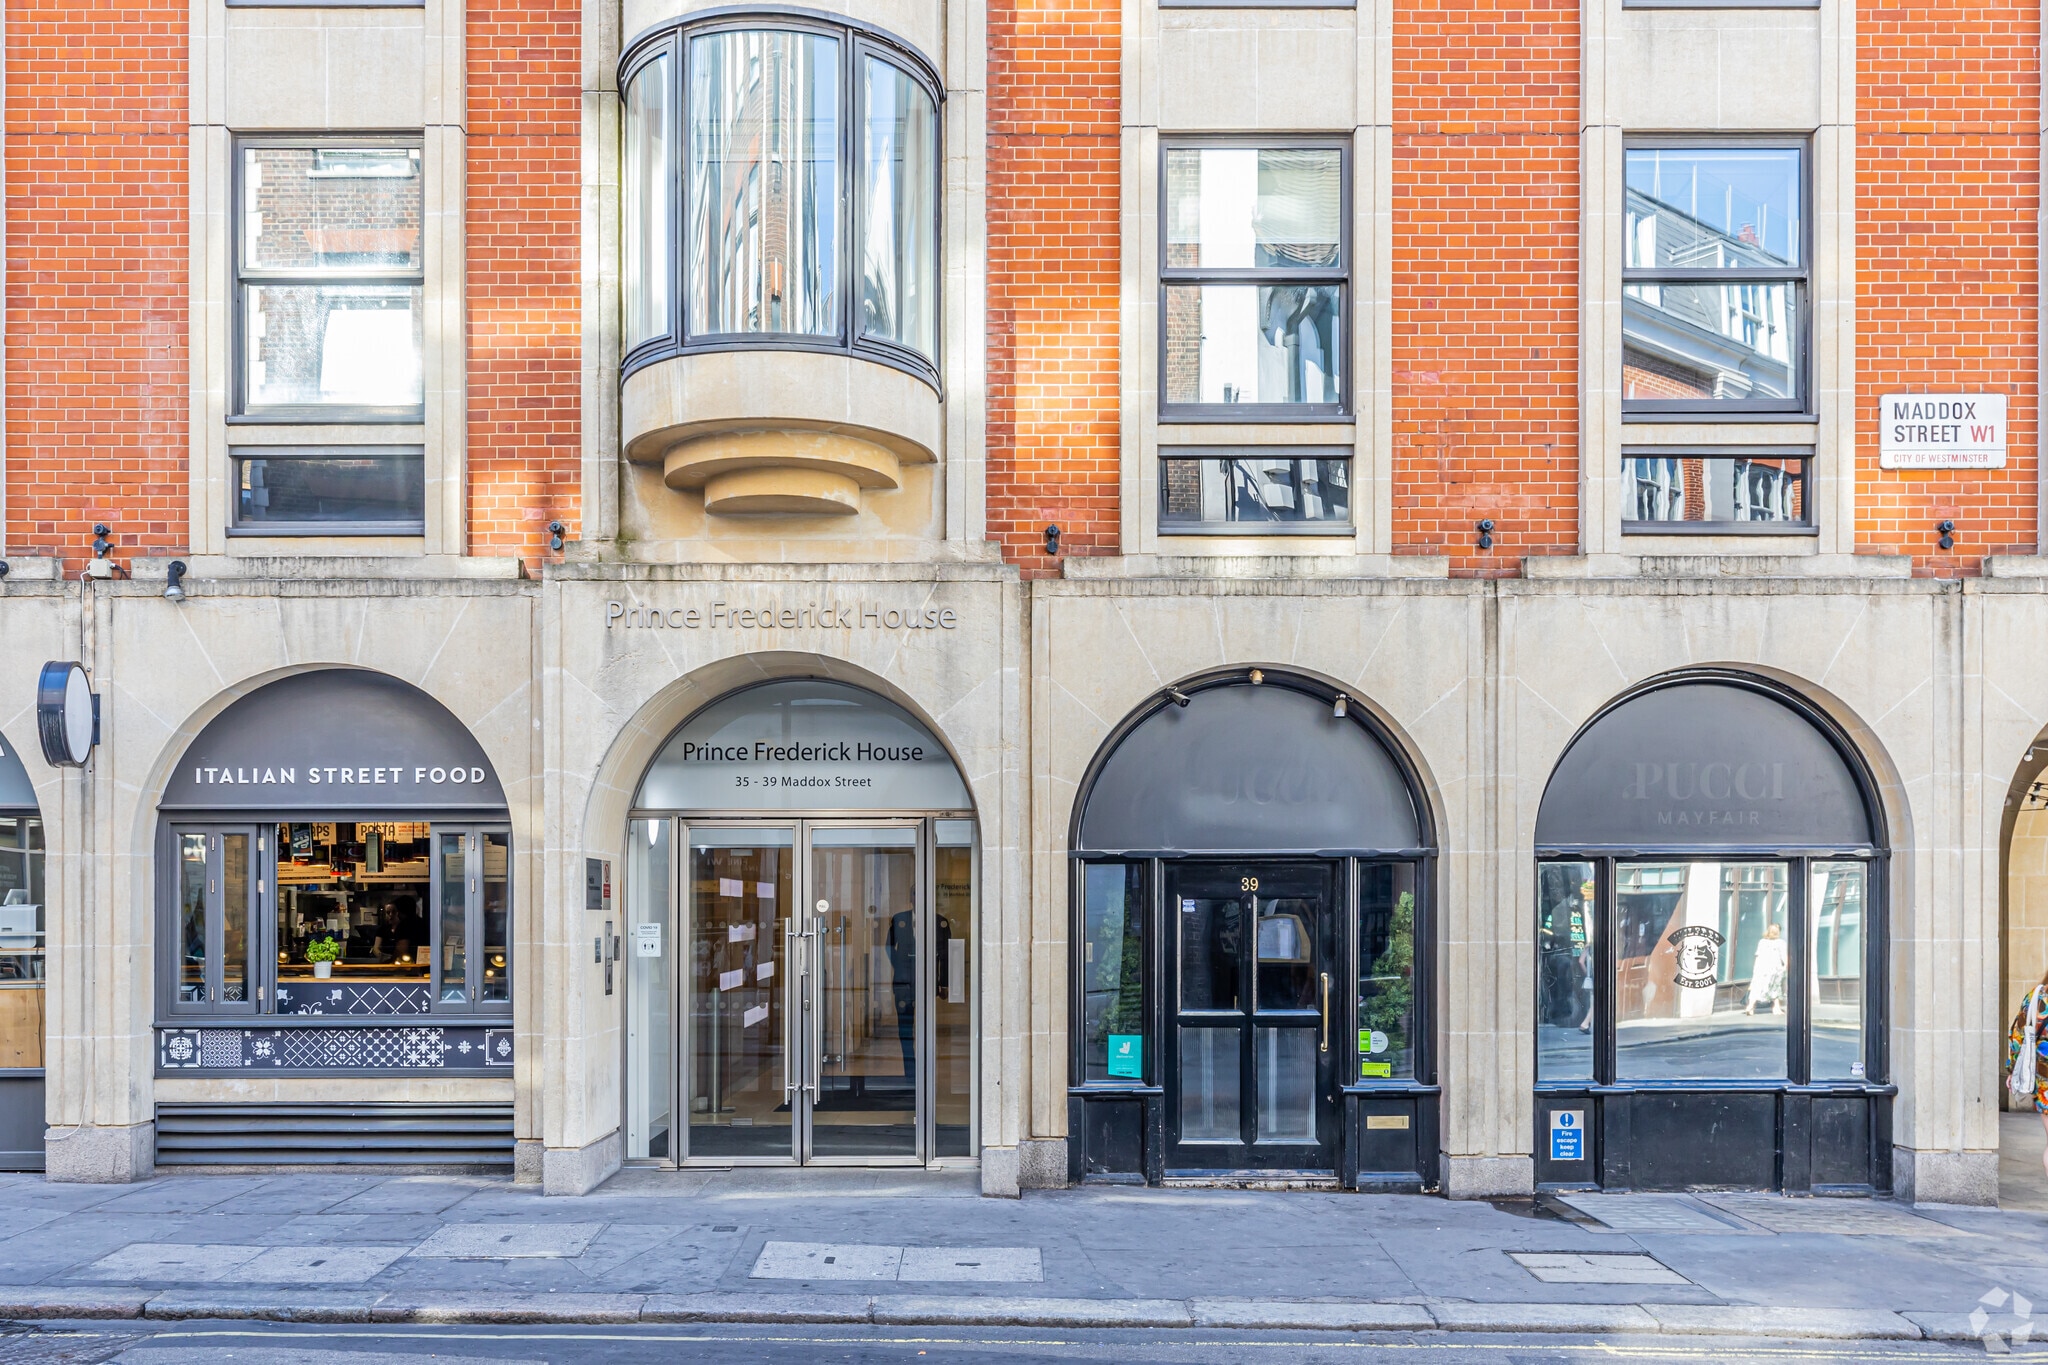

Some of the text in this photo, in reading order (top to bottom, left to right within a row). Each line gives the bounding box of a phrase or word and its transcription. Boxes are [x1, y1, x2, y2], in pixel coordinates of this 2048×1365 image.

[1894, 402, 1976, 420] MADDOX
[1894, 425, 1995, 442] STREET W1
[1894, 454, 1988, 463] CITY OF WESTMINSTER
[606, 600, 957, 629] Prince Frederick House
[683, 742, 923, 761] Prince Frederick House
[195, 767, 486, 784] ITALIAN STREET FOOD
[735, 776, 750, 787] 35
[762, 776, 777, 787] 39
[781, 775, 831, 787] Maddox
[835, 775, 872, 787] Street
[1622, 762, 1785, 800] PUCCI
[1658, 811, 1760, 825] MAYFAIR
[1241, 877, 1259, 891] 39
[1694, 976, 1713, 987] 2007
